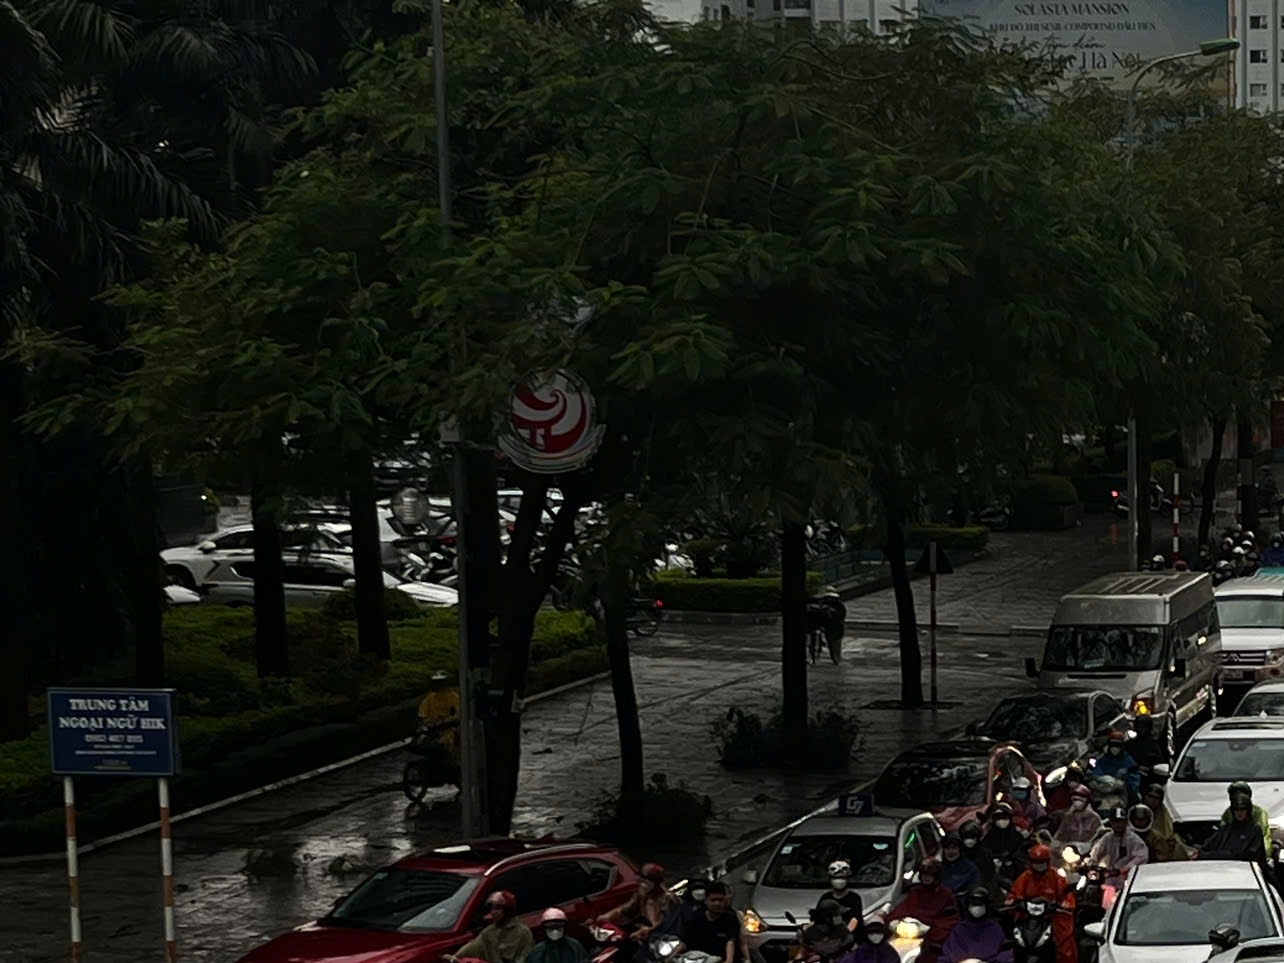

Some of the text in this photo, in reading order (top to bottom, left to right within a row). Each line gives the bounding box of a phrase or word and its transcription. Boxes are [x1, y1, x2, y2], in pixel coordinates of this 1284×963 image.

[1070, 3, 1130, 16] MANSION
[68, 696, 150, 712] TRUNG TÂM
[58, 716, 104, 732] NGOẠI
